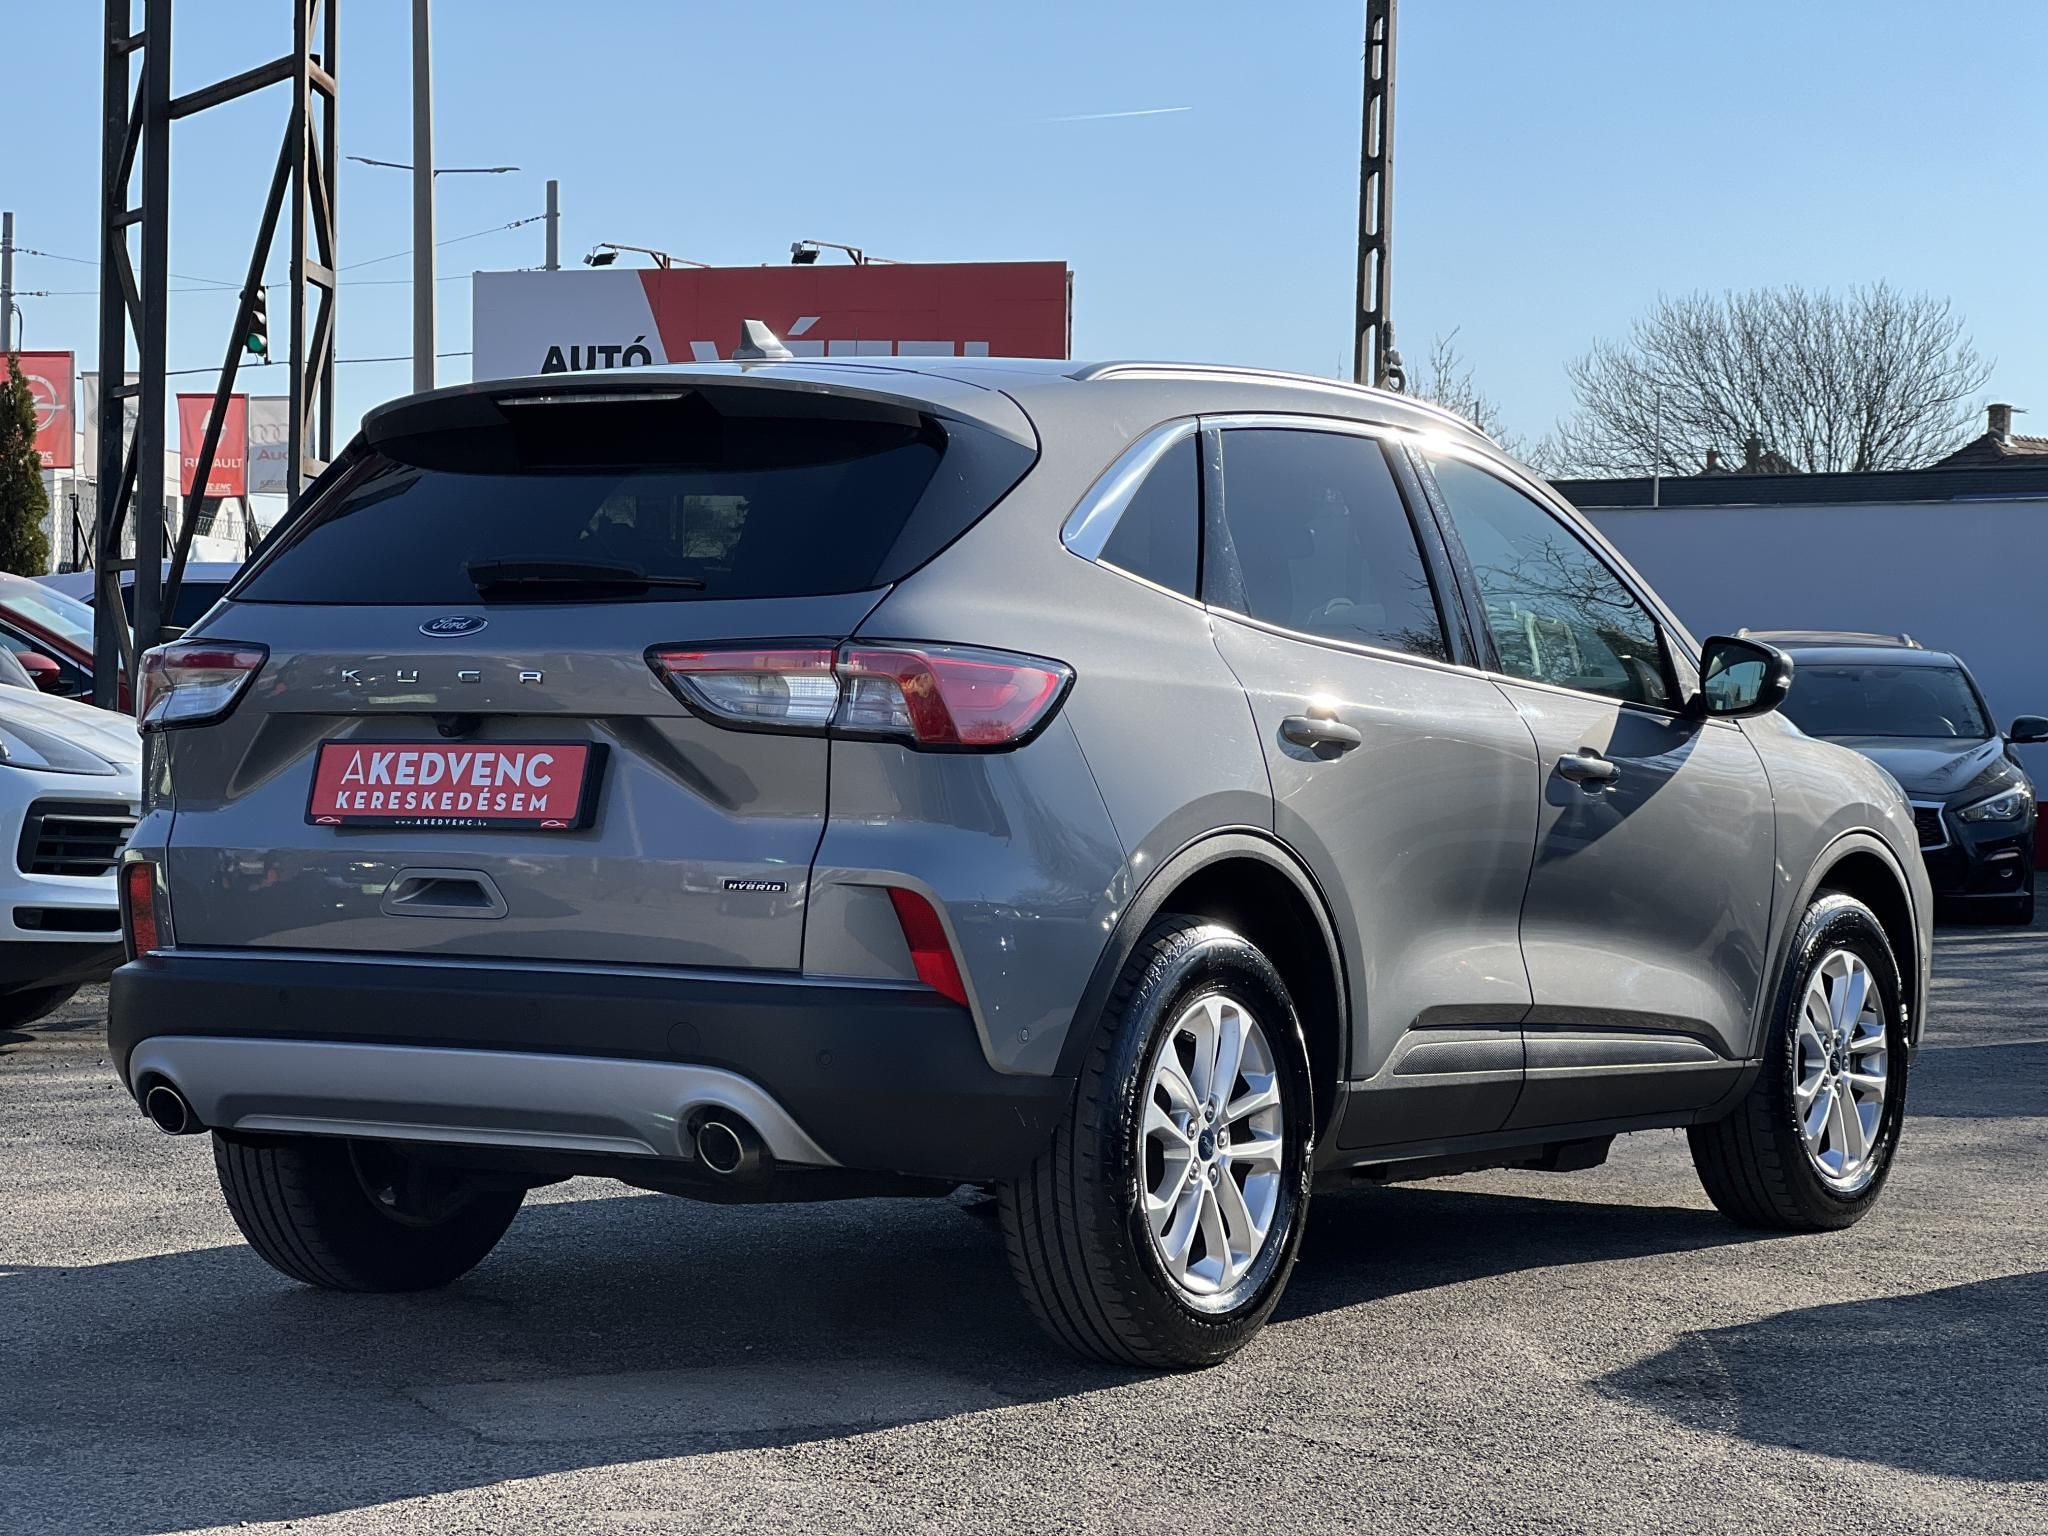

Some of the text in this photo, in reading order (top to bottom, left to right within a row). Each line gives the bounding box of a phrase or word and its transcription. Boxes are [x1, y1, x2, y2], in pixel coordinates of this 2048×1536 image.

[541, 336, 651, 374] AUTÓ
[431, 616, 473, 630] Ford
[341, 669, 543, 684] KUGA
[335, 787, 548, 812] KERESKEDÉSEM
[728, 883, 781, 891] HYBRID
